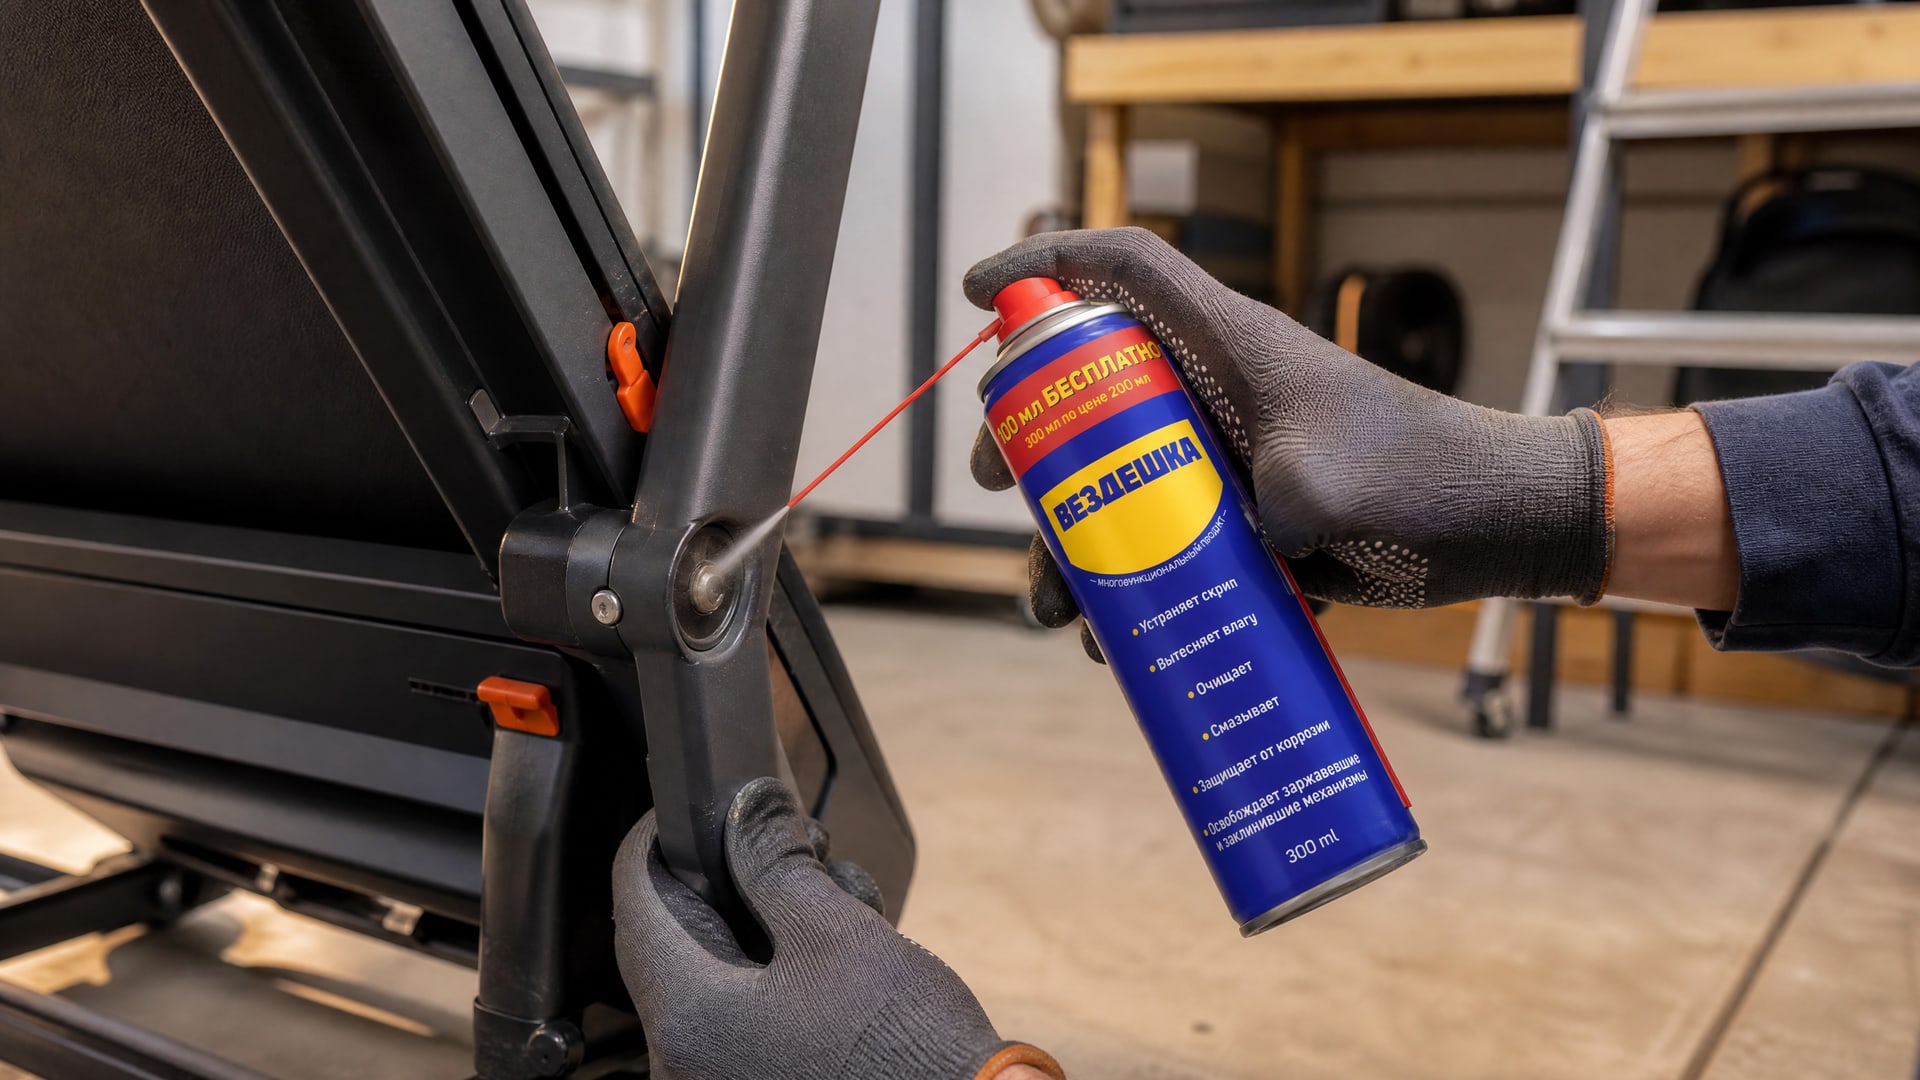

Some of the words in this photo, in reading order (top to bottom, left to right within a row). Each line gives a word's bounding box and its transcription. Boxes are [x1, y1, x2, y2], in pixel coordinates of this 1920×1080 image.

[997, 415, 1020, 444] 100
[1018, 400, 1044, 426] мл
[1041, 340, 1162, 408] БЕСПЛАТНО
[1025, 428, 1045, 448] 300
[1045, 419, 1062, 435] мл
[1062, 410, 1077, 425] по
[1078, 392, 1108, 415] цене
[1108, 378, 1134, 398] 200
[1134, 374, 1151, 387] мл
[1053, 436, 1202, 532] ВЕЗДЕШКА
[1139, 595, 1199, 633] Устраняет
[1201, 578, 1238, 598] скрип
[1156, 629, 1221, 671] Вытесняет
[1222, 613, 1257, 636] влагу
[1195, 660, 1253, 695] Очищает
[1210, 696, 1280, 737] Смазывает
[1198, 755, 1258, 792] Защищает
[1260, 746, 1274, 761] от
[1276, 720, 1331, 752] коррозии
[1207, 790, 1281, 835] Освобождает
[1282, 753, 1360, 797] заржавевшие
[1216, 840, 1224, 852] и
[1222, 801, 1302, 848] заклинившие
[1302, 769, 1368, 807] механизмы
[1285, 839, 1317, 864] 300
[1319, 828, 1340, 848] ml
